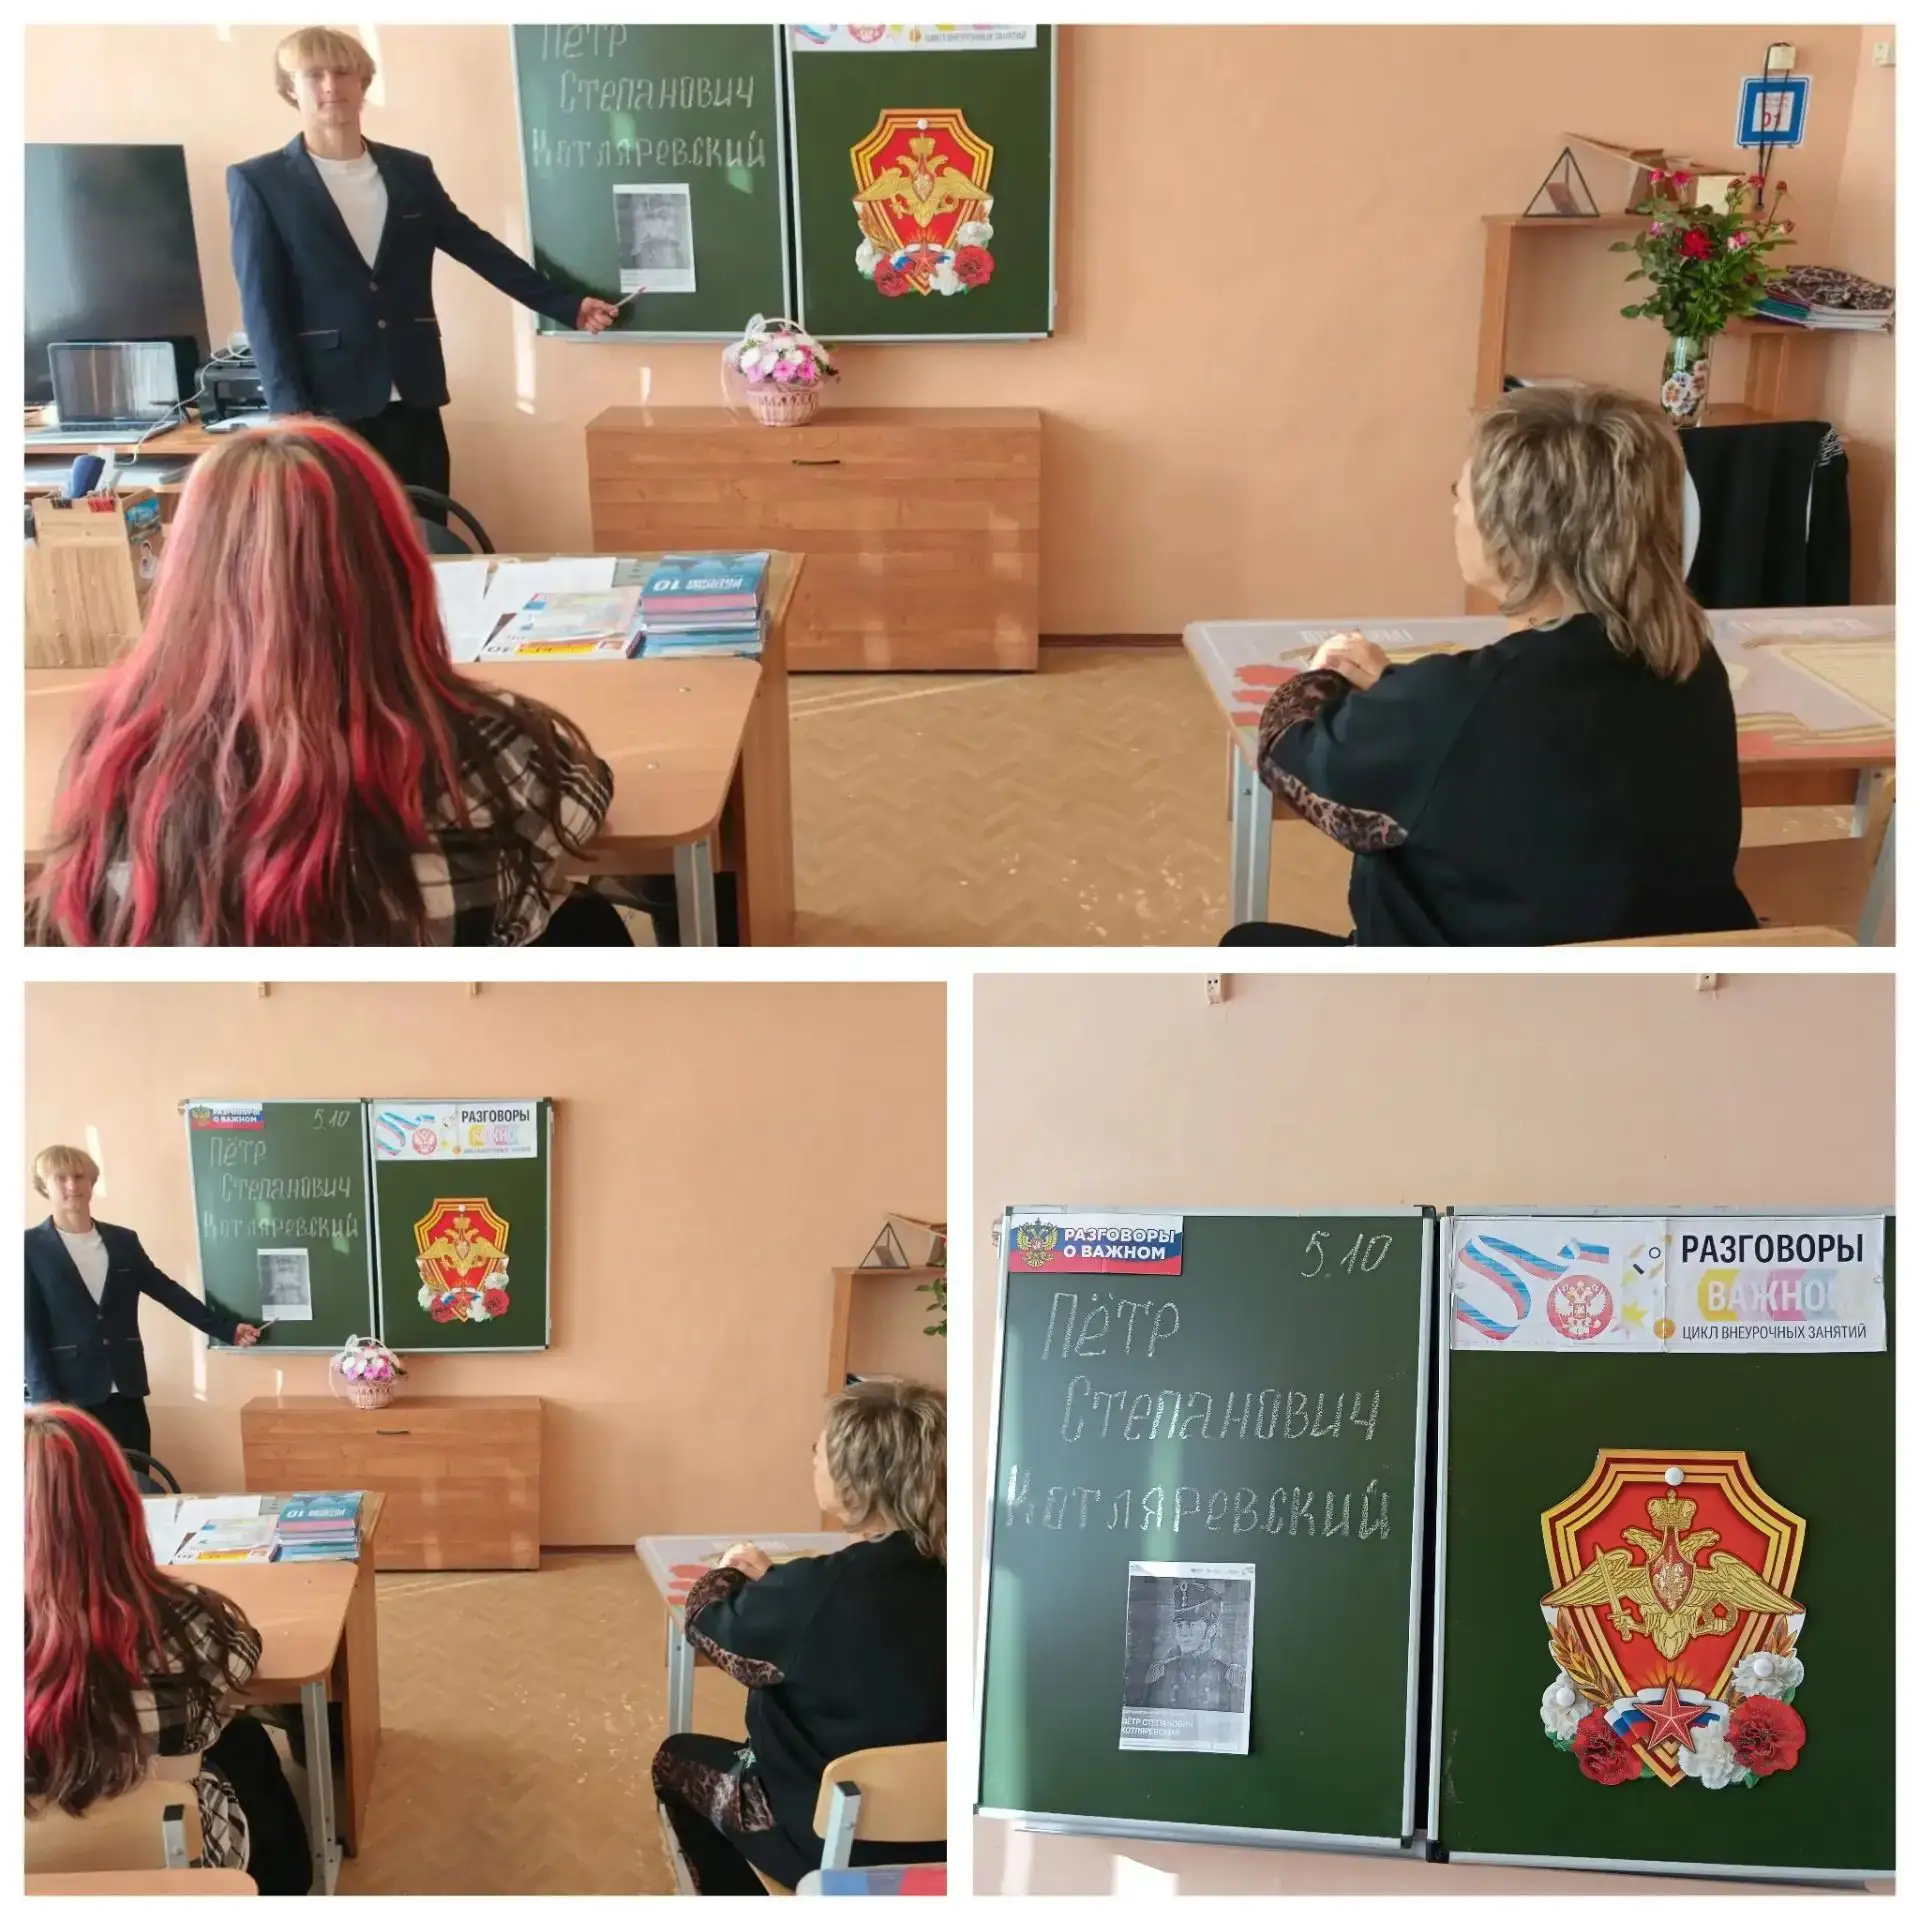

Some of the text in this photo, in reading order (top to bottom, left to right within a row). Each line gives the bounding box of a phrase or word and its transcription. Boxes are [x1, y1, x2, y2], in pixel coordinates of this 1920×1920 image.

[560, 69, 754, 112] Степанович
[461, 1109, 531, 1123] РАЗГОВОРЫ
[210, 1136, 266, 1167] Пётр
[222, 1173, 351, 1202] Степанович
[1064, 1228, 1176, 1243] РАЗГОВОРЫ
[1681, 1233, 1864, 1264] РАЗГОВОРЫ
[1063, 1244, 1166, 1260] О ВАЖНОМ
[1042, 1292, 1181, 1360] Пётр
[1682, 1323, 1867, 1341] ЦИКЛ ВНЕУРОЧНЫХ ЗАНЯТИЙ
[1061, 1376, 1380, 1443] Степанович
[1005, 1464, 1392, 1540] Котляревский
